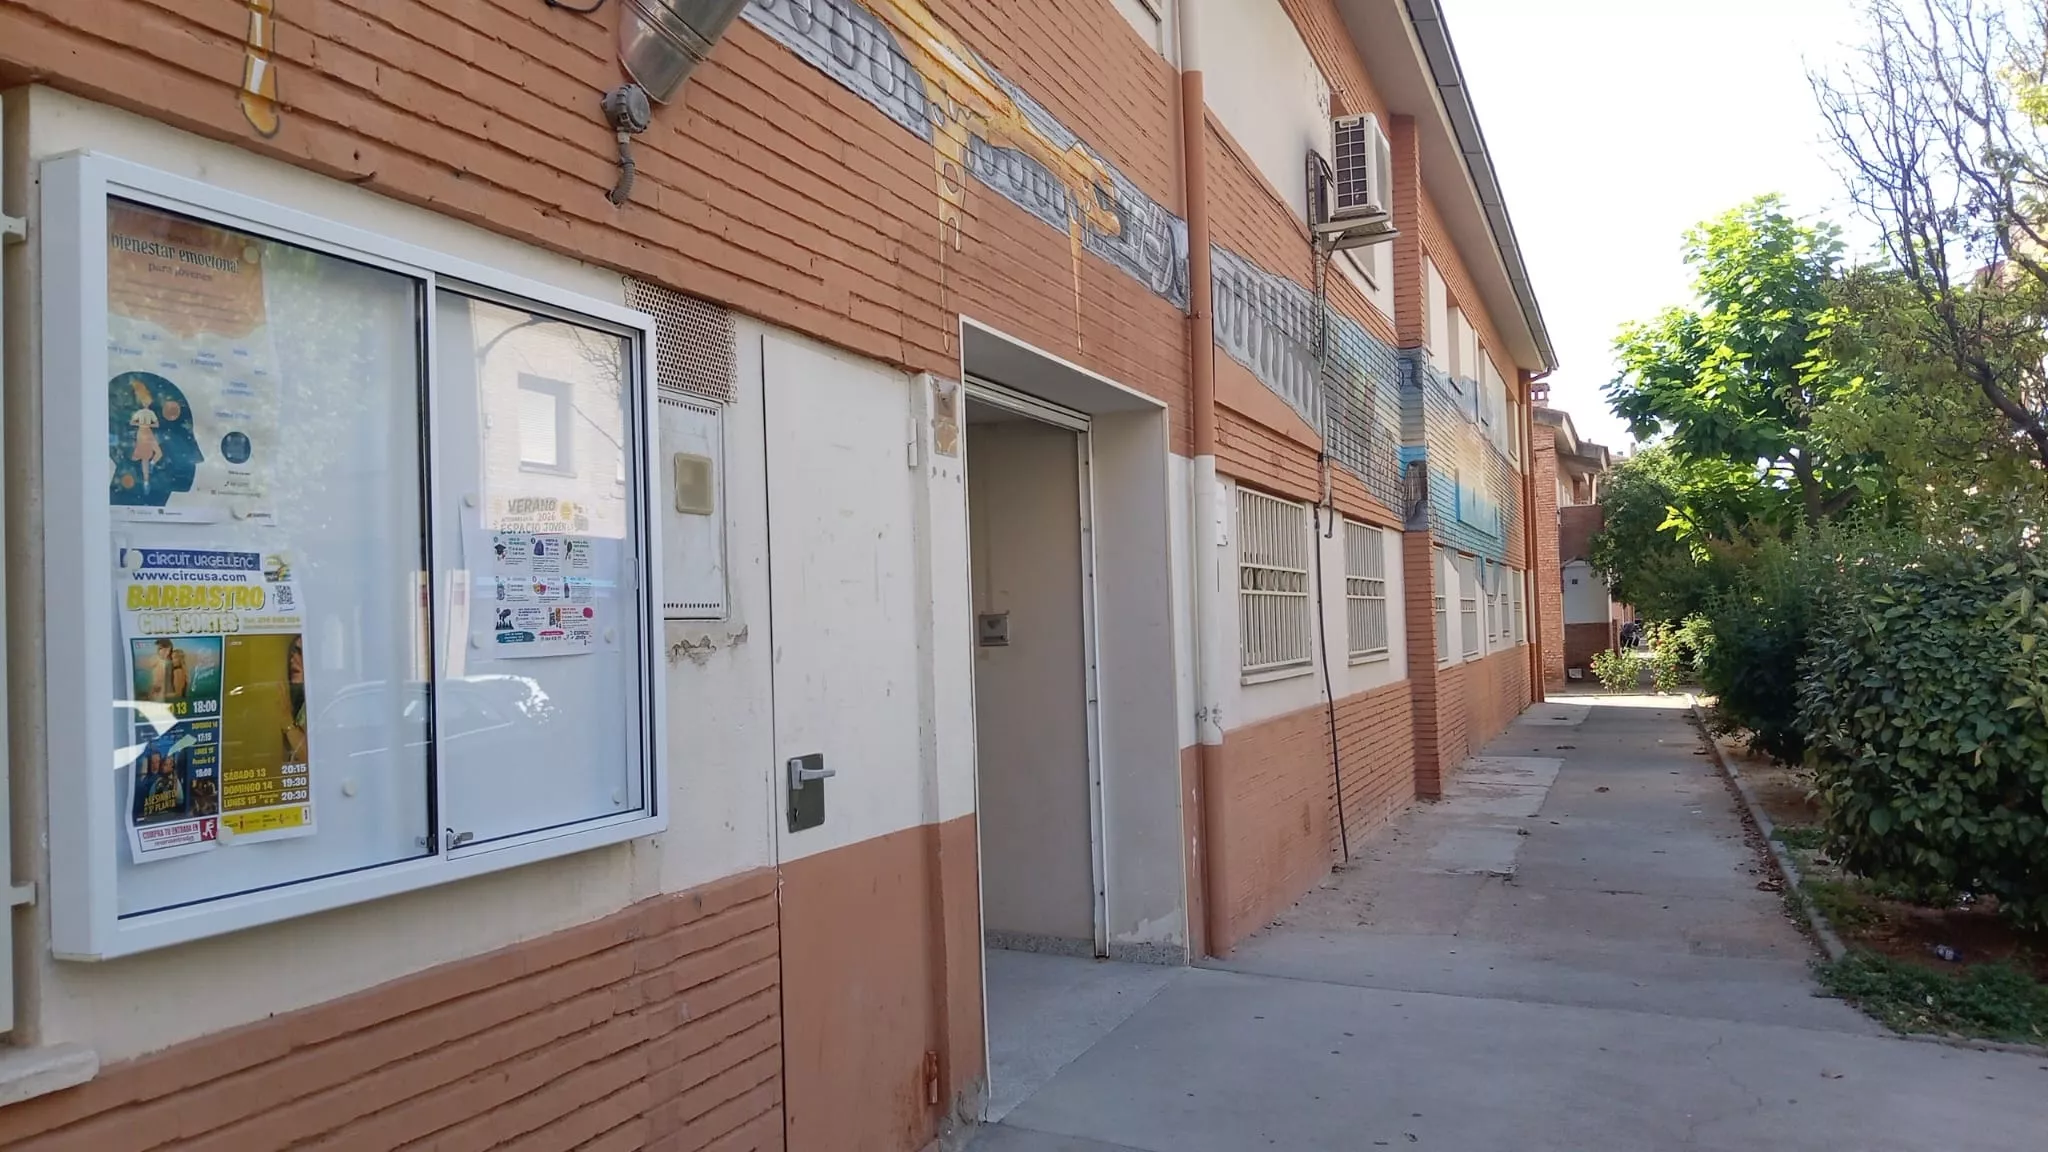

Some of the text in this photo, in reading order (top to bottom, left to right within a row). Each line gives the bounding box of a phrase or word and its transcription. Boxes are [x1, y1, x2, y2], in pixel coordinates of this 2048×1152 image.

[112, 233, 175, 260] bienestar
[148, 262, 172, 274] para
[508, 498, 556, 514] VERANO
[500, 522, 540, 535] ESPACIO
[132, 571, 247, 583] www.circusa.com
[127, 584, 266, 612] BARBASTRO
[138, 612, 179, 635] CINE
[176, 701, 187, 714] 13
[193, 700, 217, 713] 18:00
[223, 764, 307, 782] SÁBADO 13 20:15
[223, 777, 307, 795] DOMINGO 14 19:30
[223, 797, 246, 808] LUNES
[247, 796, 257, 805] 15
[281, 790, 307, 801] 20:30
